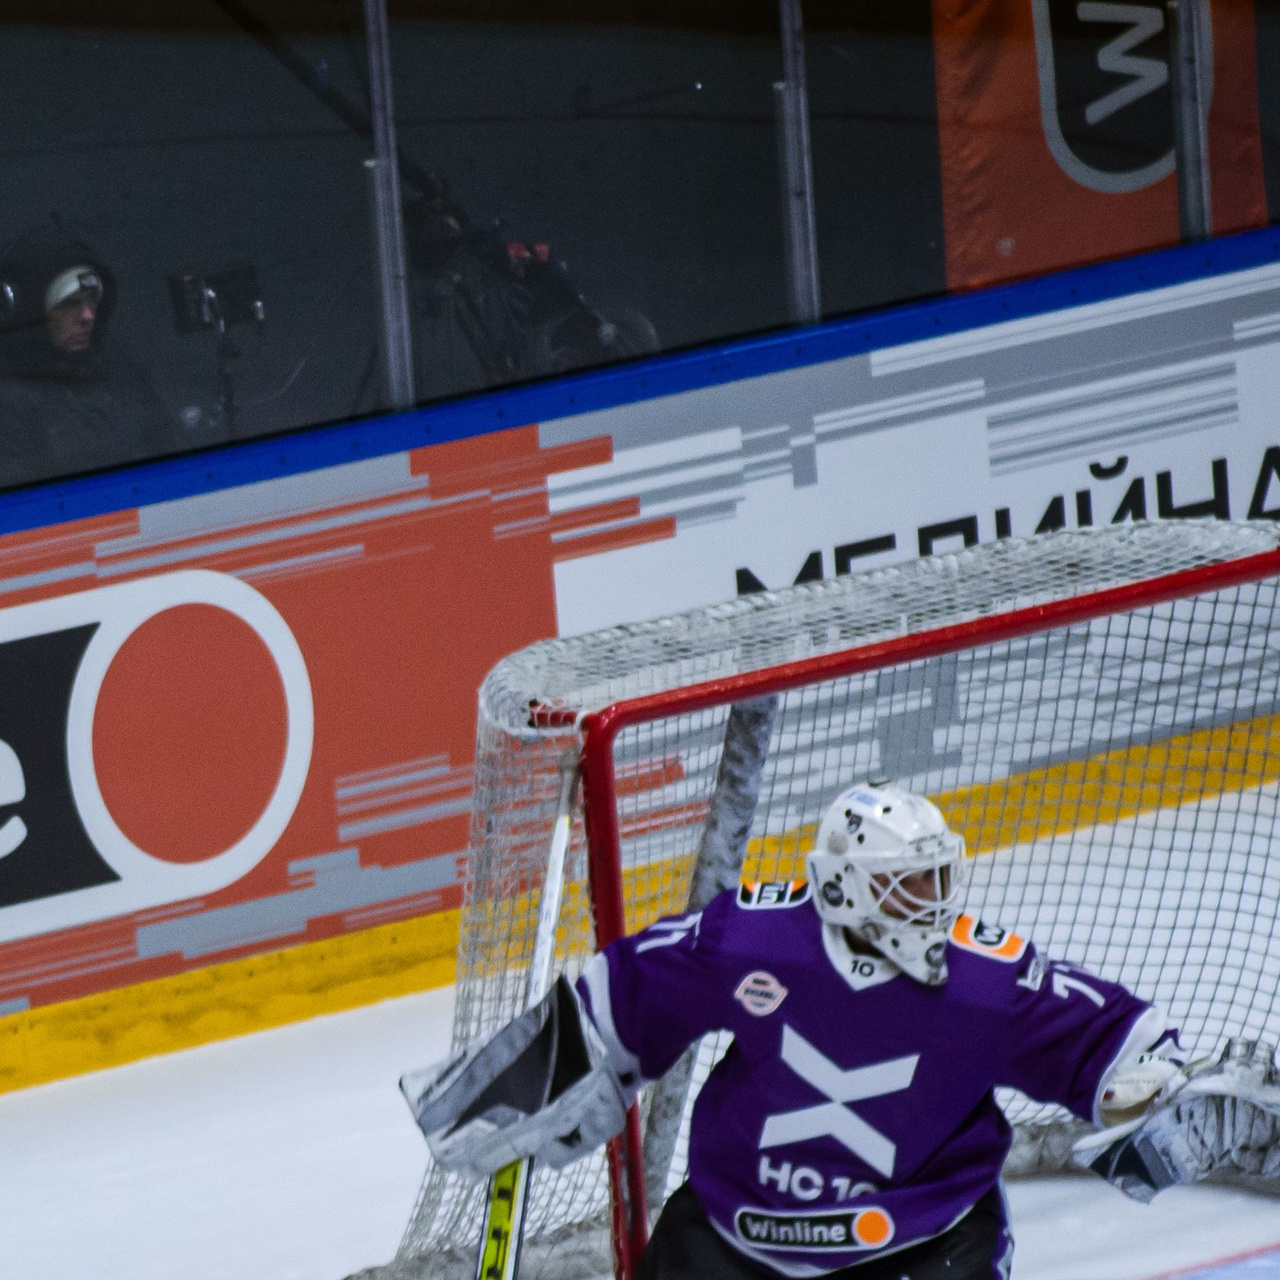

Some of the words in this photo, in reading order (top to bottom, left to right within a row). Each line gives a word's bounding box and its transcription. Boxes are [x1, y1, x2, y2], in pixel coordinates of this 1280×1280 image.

[851, 960, 874, 977] 10
[759, 1156, 824, 1201] HC
[744, 1215, 847, 1242] Winline
